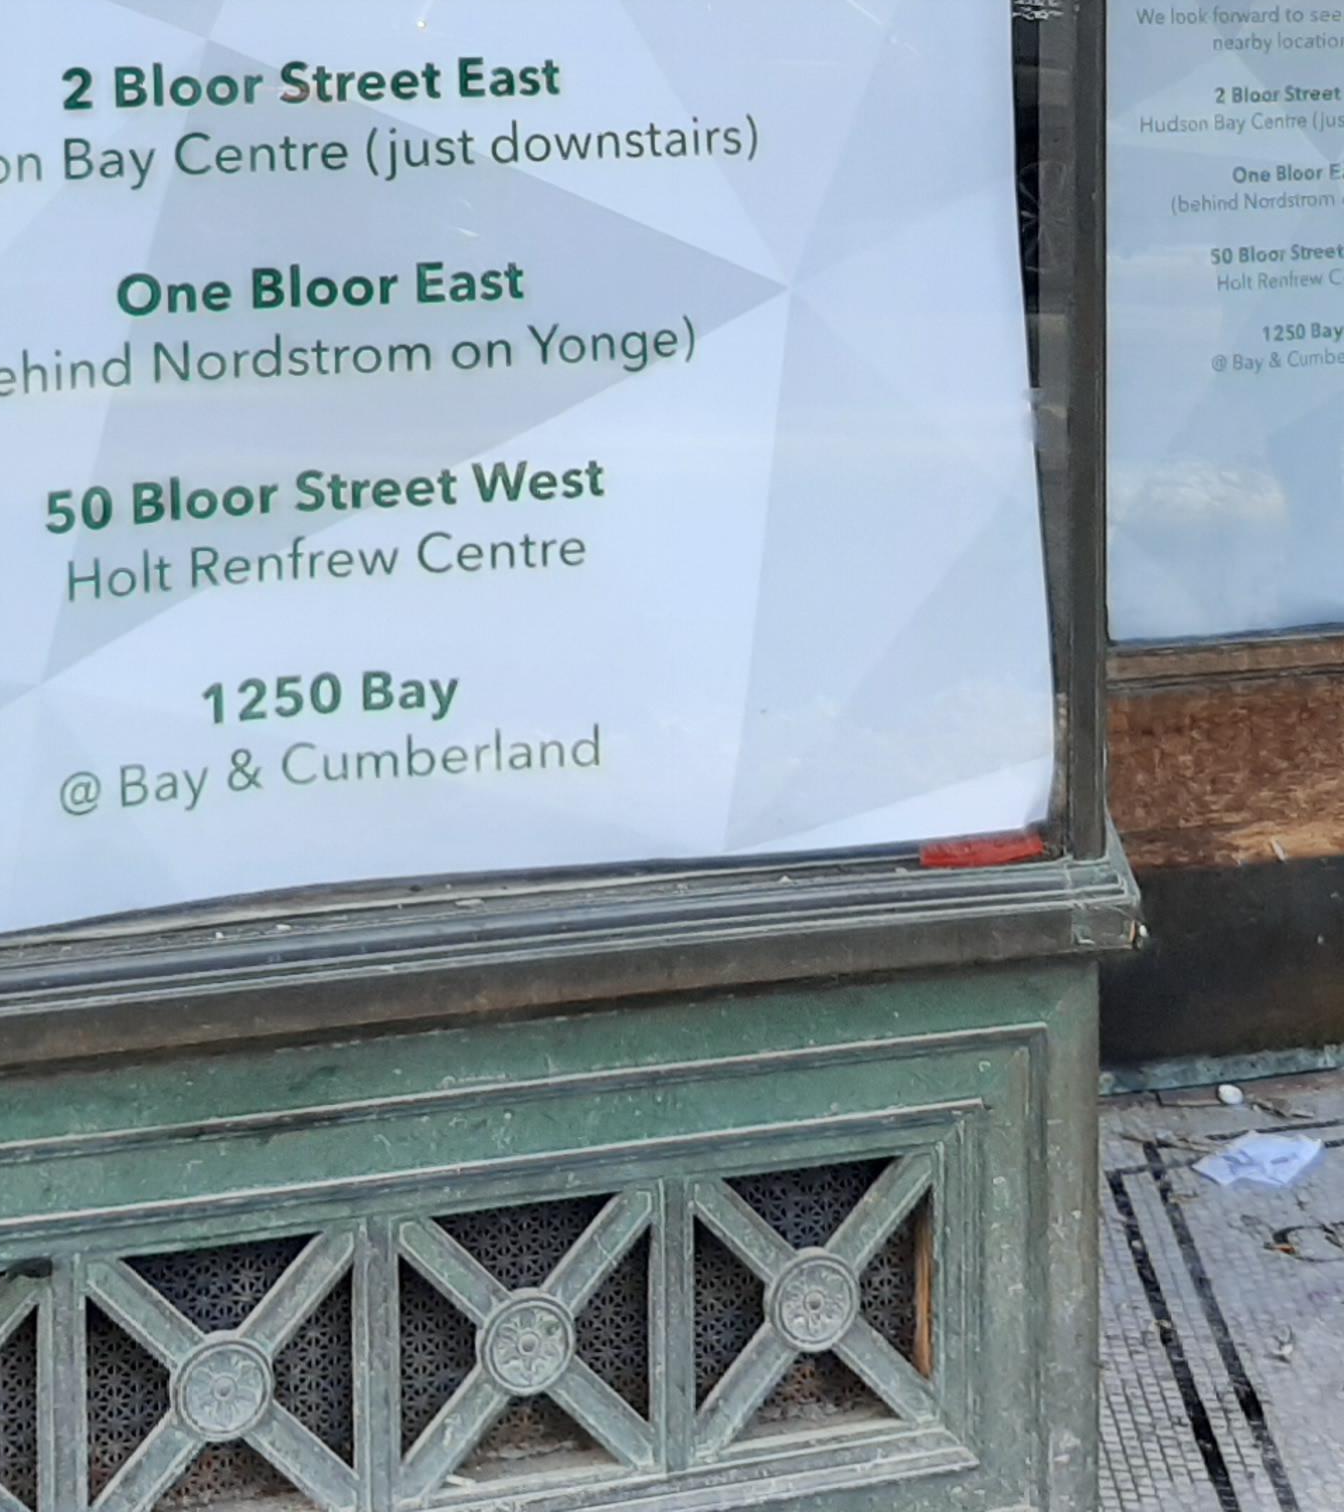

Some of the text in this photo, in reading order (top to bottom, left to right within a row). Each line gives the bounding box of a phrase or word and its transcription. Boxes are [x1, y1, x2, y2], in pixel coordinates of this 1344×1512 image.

[1136, 8, 1165, 24] We
[1171, 8, 1208, 24] look
[1213, 6, 1280, 24] forward
[1285, 9, 1304, 22] to
[1213, 33, 1272, 54] nearby
[62, 58, 559, 109] 2 Bloor Street East
[1215, 88, 1226, 104] 2
[1231, 87, 1279, 102] Bloor
[1285, 86, 1342, 102] Street
[1140, 116, 1208, 133] Hudson
[1214, 114, 1247, 135] Bay
[1251, 112, 1306, 130] Centre
[64, 139, 154, 190] Bay
[175, 132, 348, 174] Centre
[367, 128, 474, 181] (just
[492, 115, 757, 163] downstairs)
[1233, 167, 1270, 183] One
[1276, 166, 1323, 180] Bloor
[1171, 193, 1238, 216] (behind
[1244, 192, 1336, 210] Nordstrom
[1211, 248, 1233, 264] 50
[1239, 246, 1285, 262] Bloor
[1290, 244, 1344, 260] Street
[117, 262, 523, 316] One Bloor East
[1217, 274, 1252, 291] Holt
[1258, 270, 1324, 290] Renfrew
[1263, 324, 1344, 342] 1250 Bay
[154, 334, 431, 382] Nordstrom
[452, 340, 511, 369] on
[528, 316, 694, 372] Yonge)
[1211, 356, 1227, 372] @
[1233, 354, 1264, 374] Bay
[1269, 352, 1281, 368] &
[46, 461, 604, 534] 50 Bloor Street West
[69, 532, 585, 601] Holt Renfrew Centre
[203, 671, 458, 724] 1250 Bay
[60, 724, 599, 816] @ Bay & Cumberland
